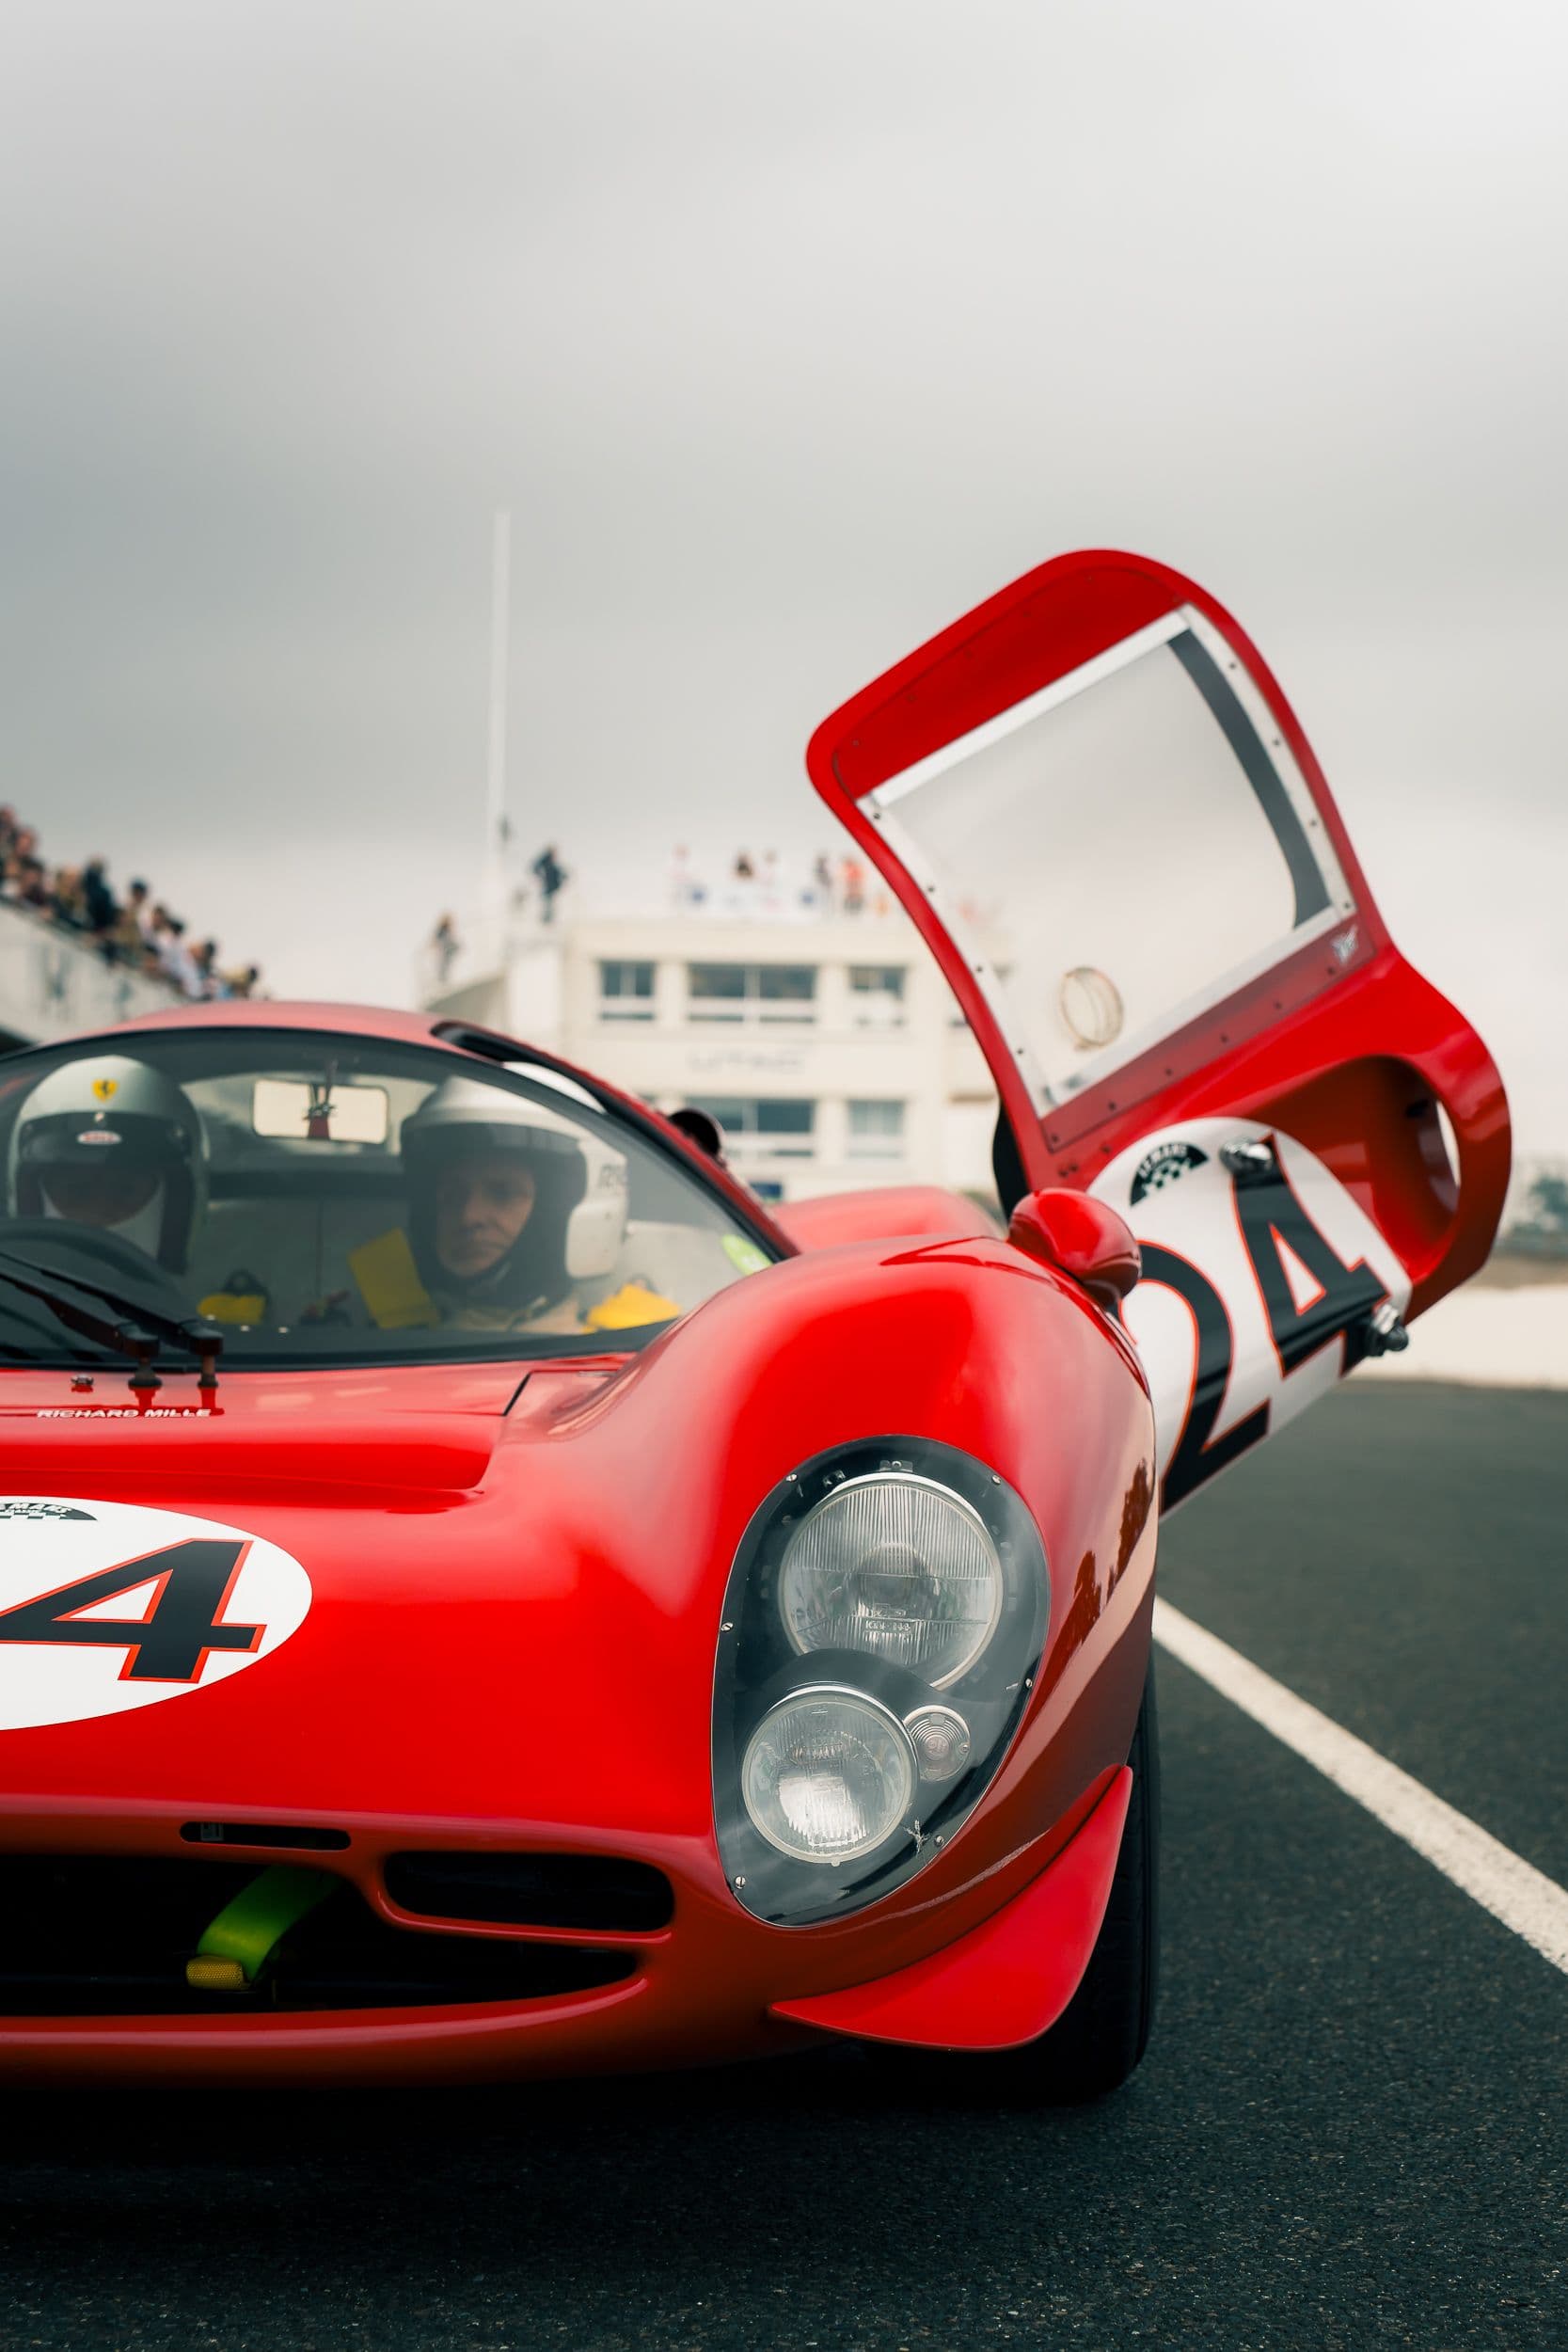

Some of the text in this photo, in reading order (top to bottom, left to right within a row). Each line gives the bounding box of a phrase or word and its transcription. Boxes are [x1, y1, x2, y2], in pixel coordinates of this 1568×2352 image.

[1119, 1134, 1390, 1515] 24
[36, 1408, 211, 1418] RICHARD MILLE
[0, 1537, 267, 1684] 4
